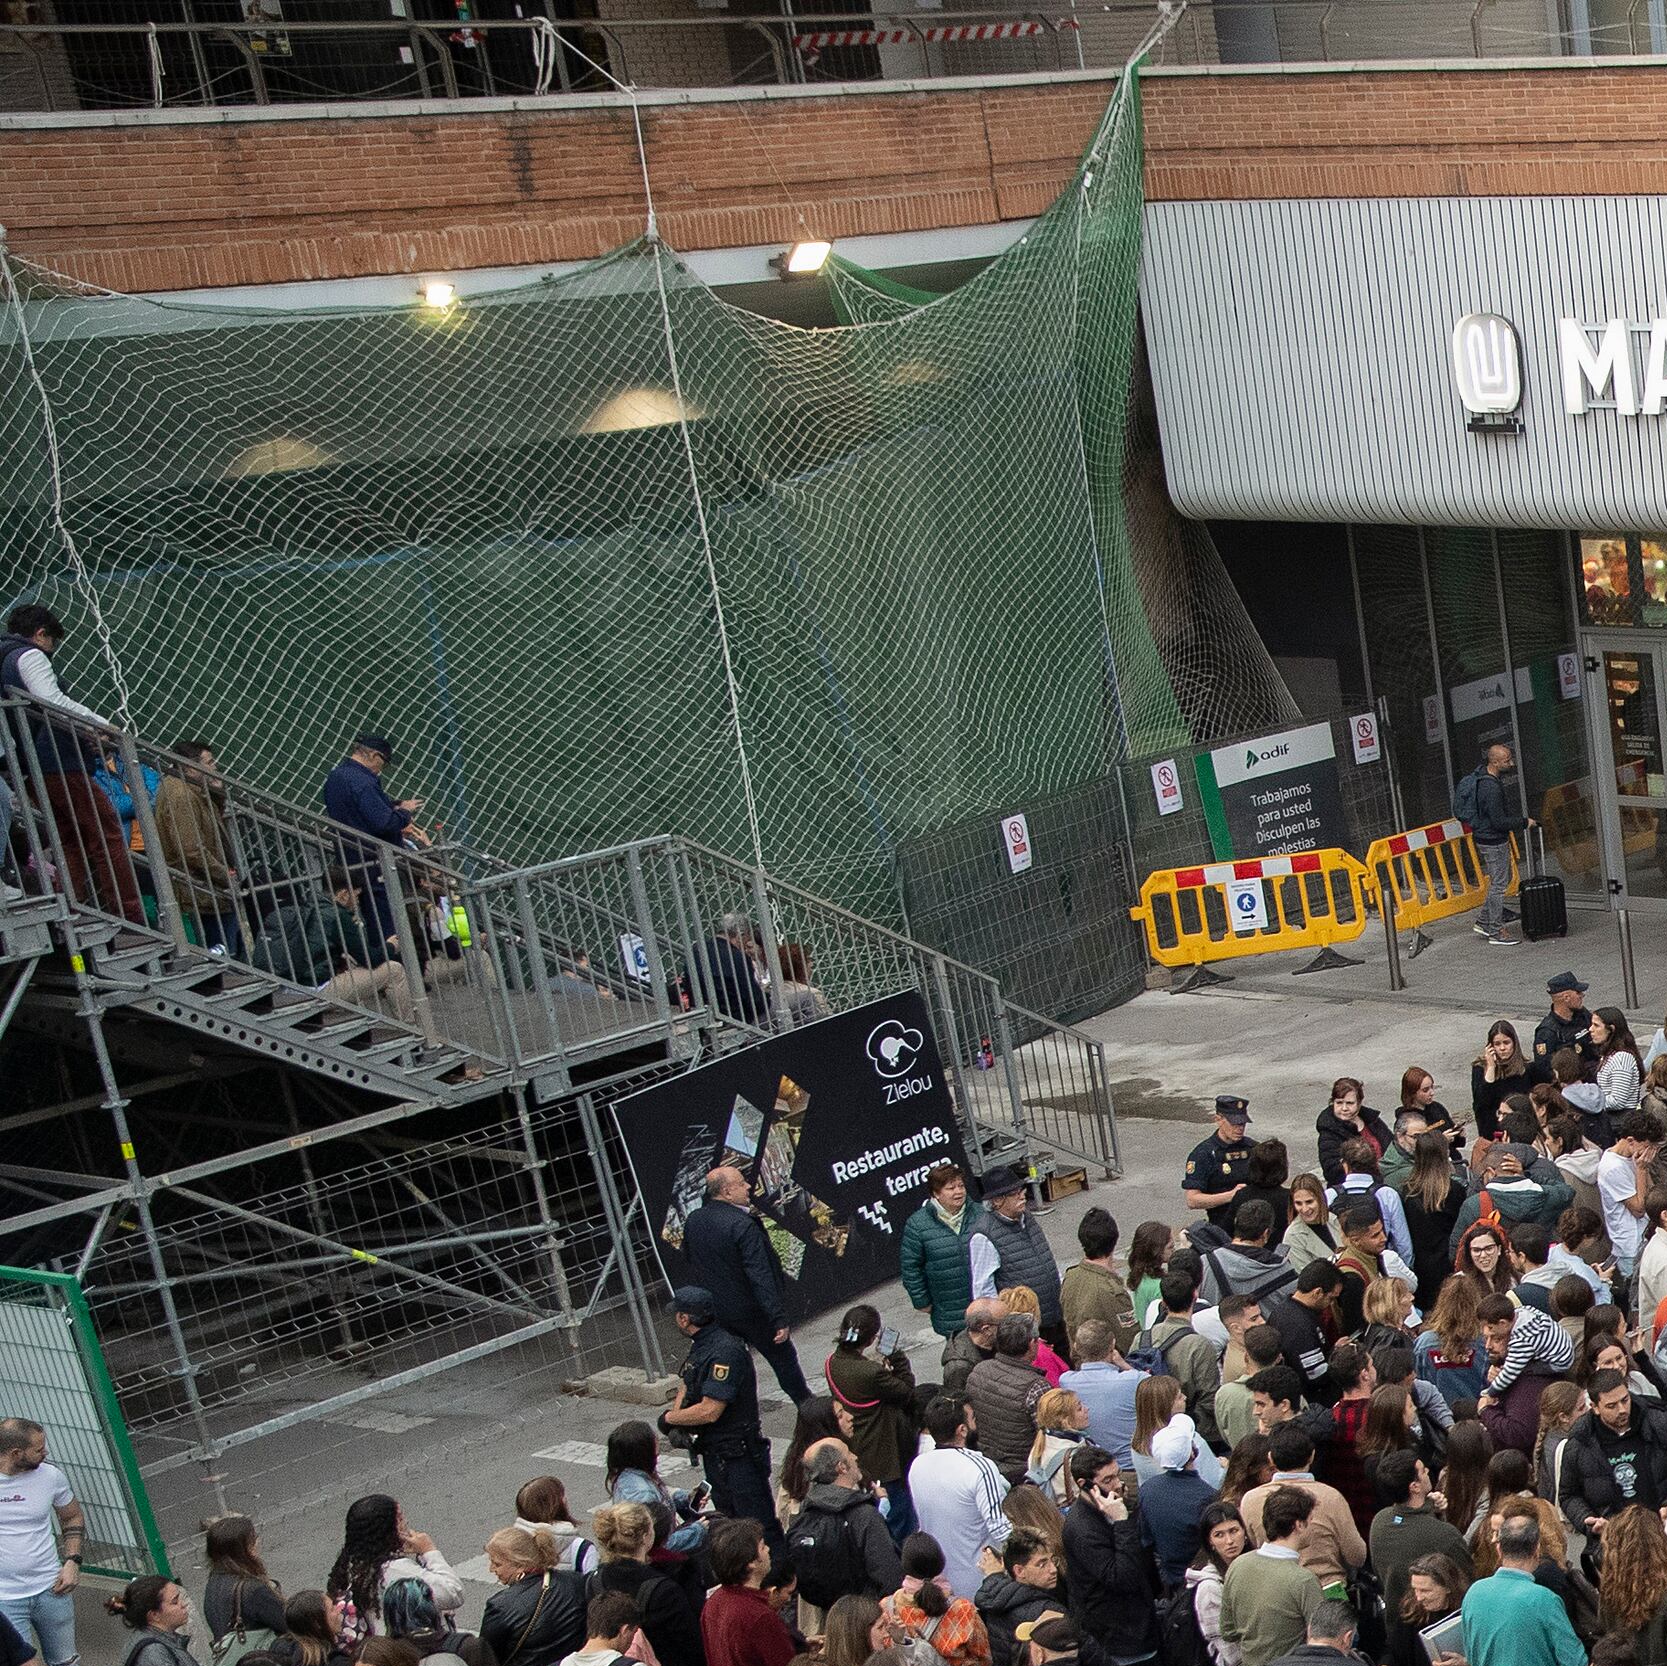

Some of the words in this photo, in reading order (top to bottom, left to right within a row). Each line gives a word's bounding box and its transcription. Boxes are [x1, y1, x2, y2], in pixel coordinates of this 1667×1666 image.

[1260, 743, 1290, 761] adif
[1251, 783, 1311, 807] Trabajamos
[1258, 810, 1281, 828] para
[1284, 799, 1312, 818] usted
[1257, 821, 1305, 844] Disculpen
[1306, 816, 1321, 830] las
[1268, 836, 1316, 857] molestias
[882, 1074, 932, 1105] Zielou
[832, 1126, 950, 1184] Restaurante,
